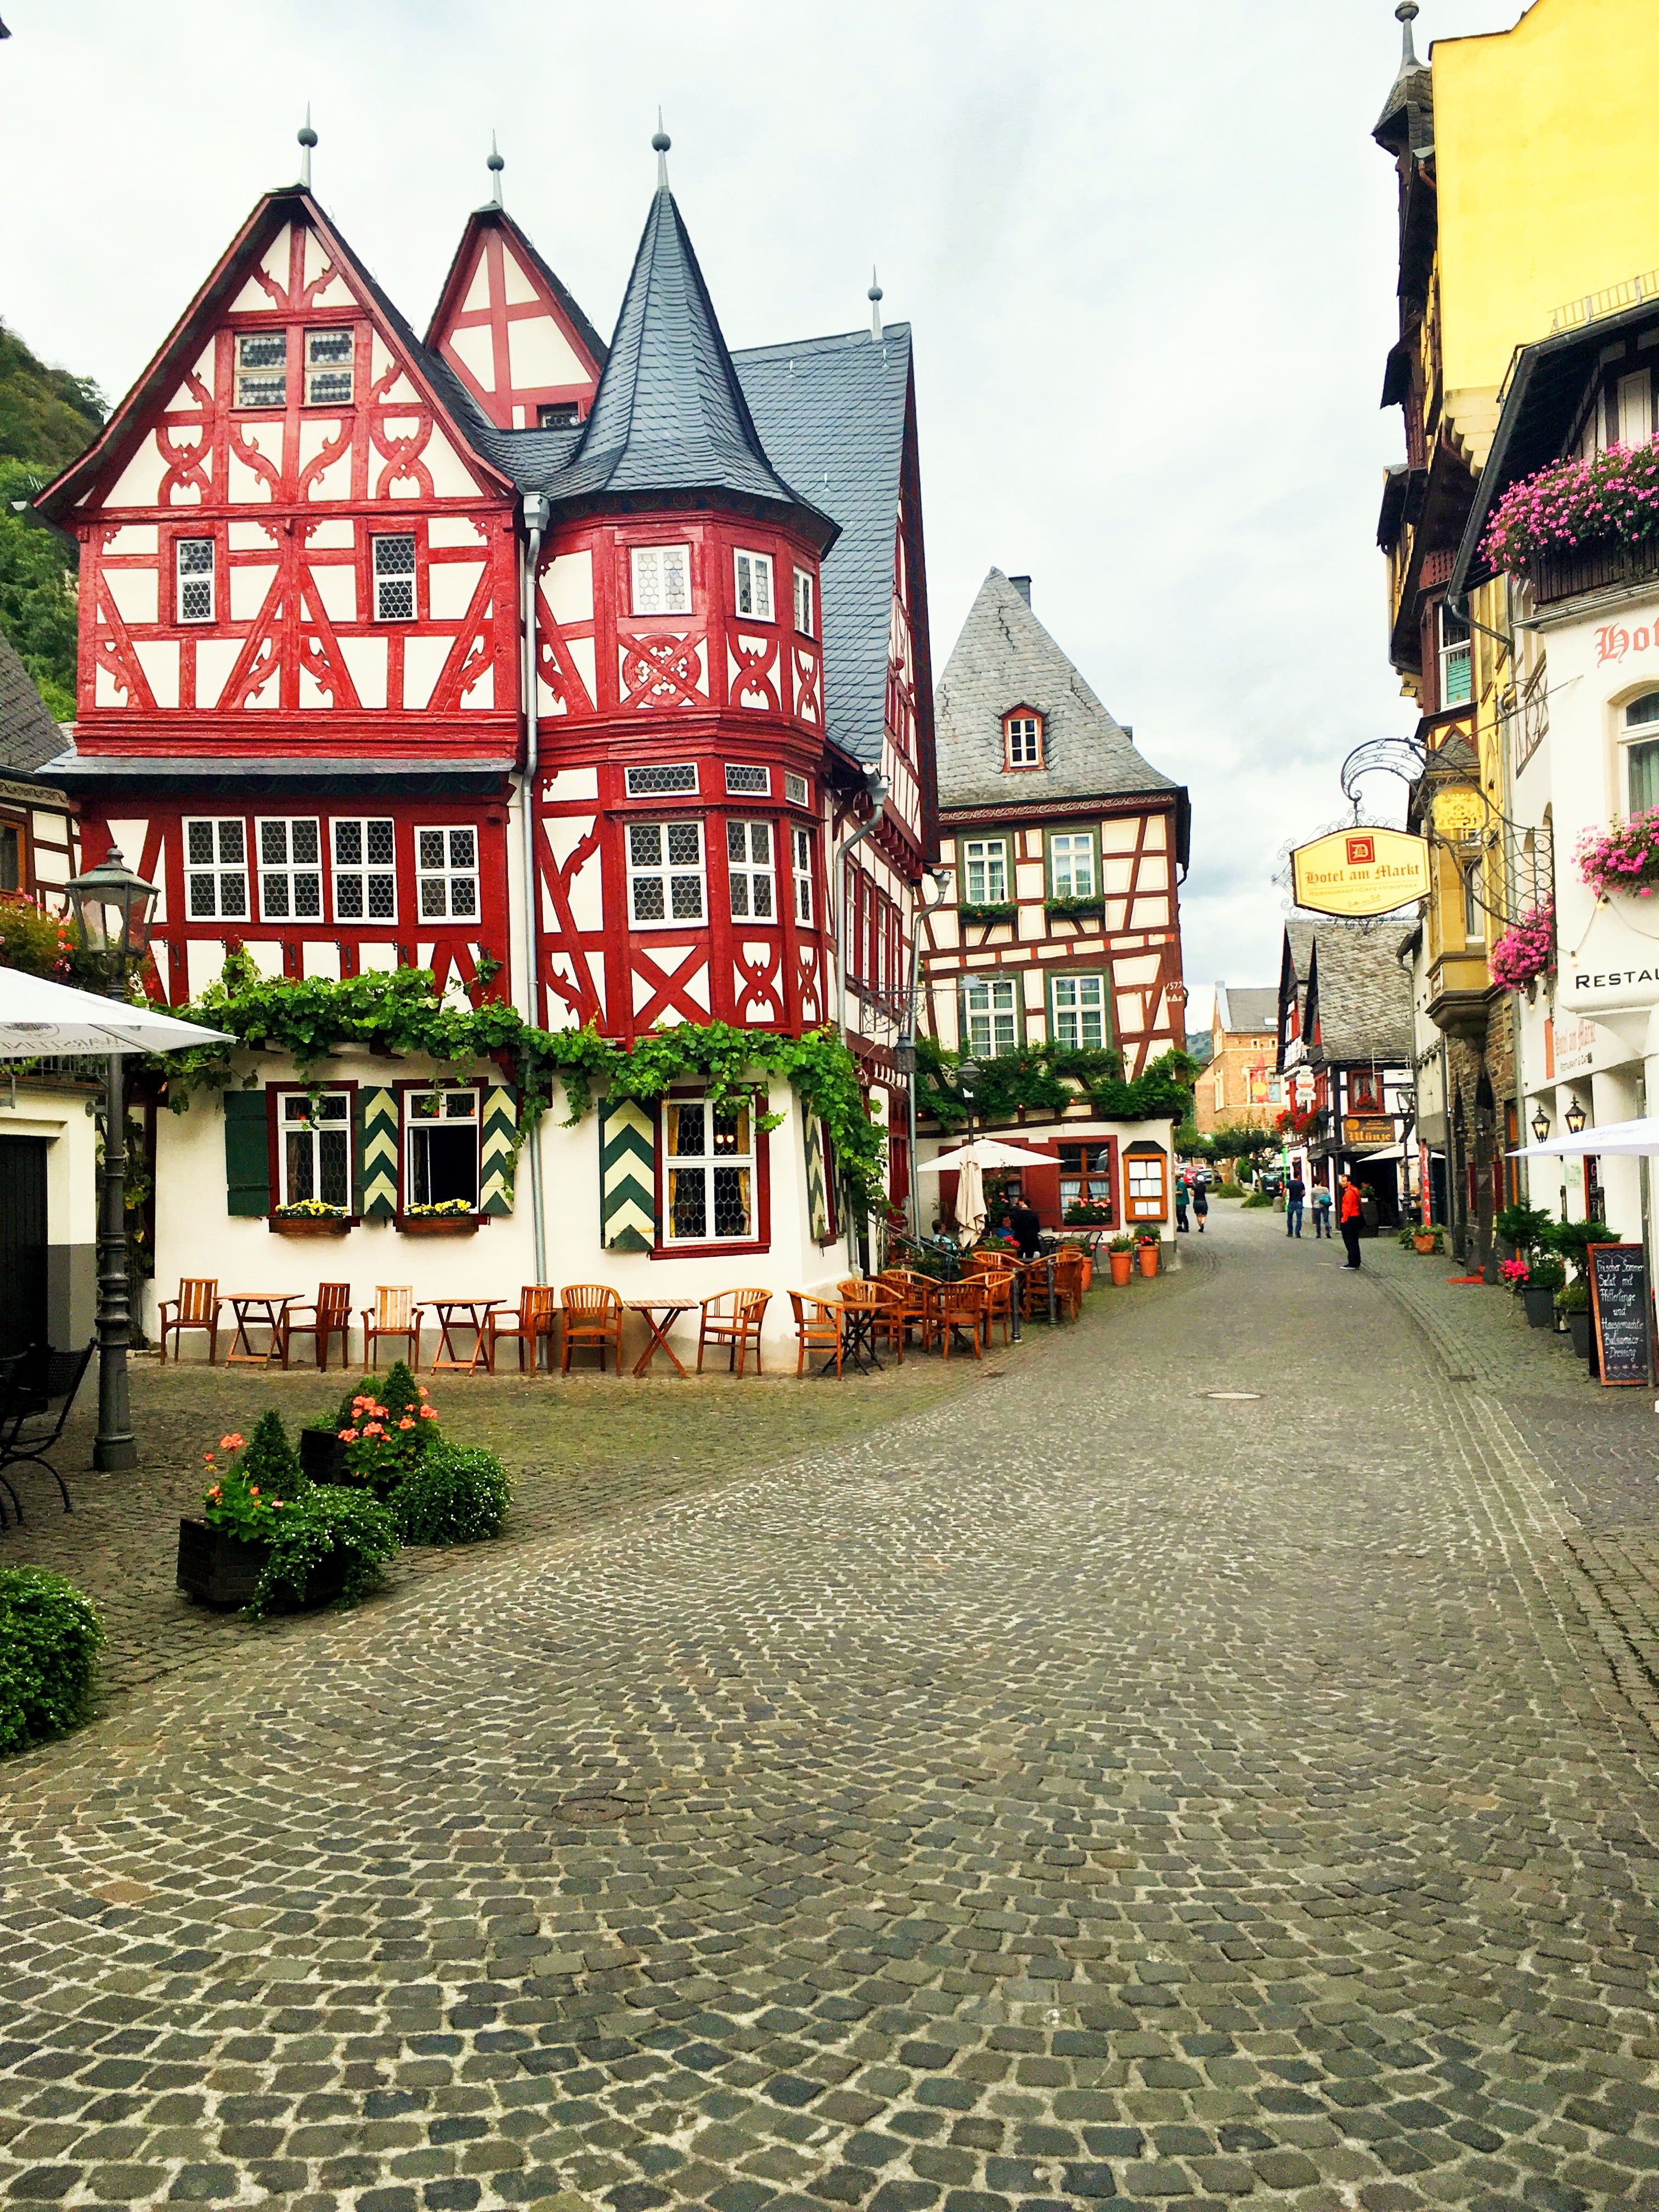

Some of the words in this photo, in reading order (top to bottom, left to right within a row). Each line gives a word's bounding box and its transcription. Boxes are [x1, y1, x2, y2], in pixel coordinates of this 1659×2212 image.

[1305, 870, 1344, 886] Hotel
[1350, 870, 1369, 880] am
[1374, 864, 1420, 879] Markt
[1596, 1259, 1621, 1272] Frischer
[1622, 1259, 1644, 1272] Sommer
[1599, 1273, 1616, 1286] Salat
[1622, 1273, 1633, 1285] mit
[1612, 1304, 1626, 1316] und
